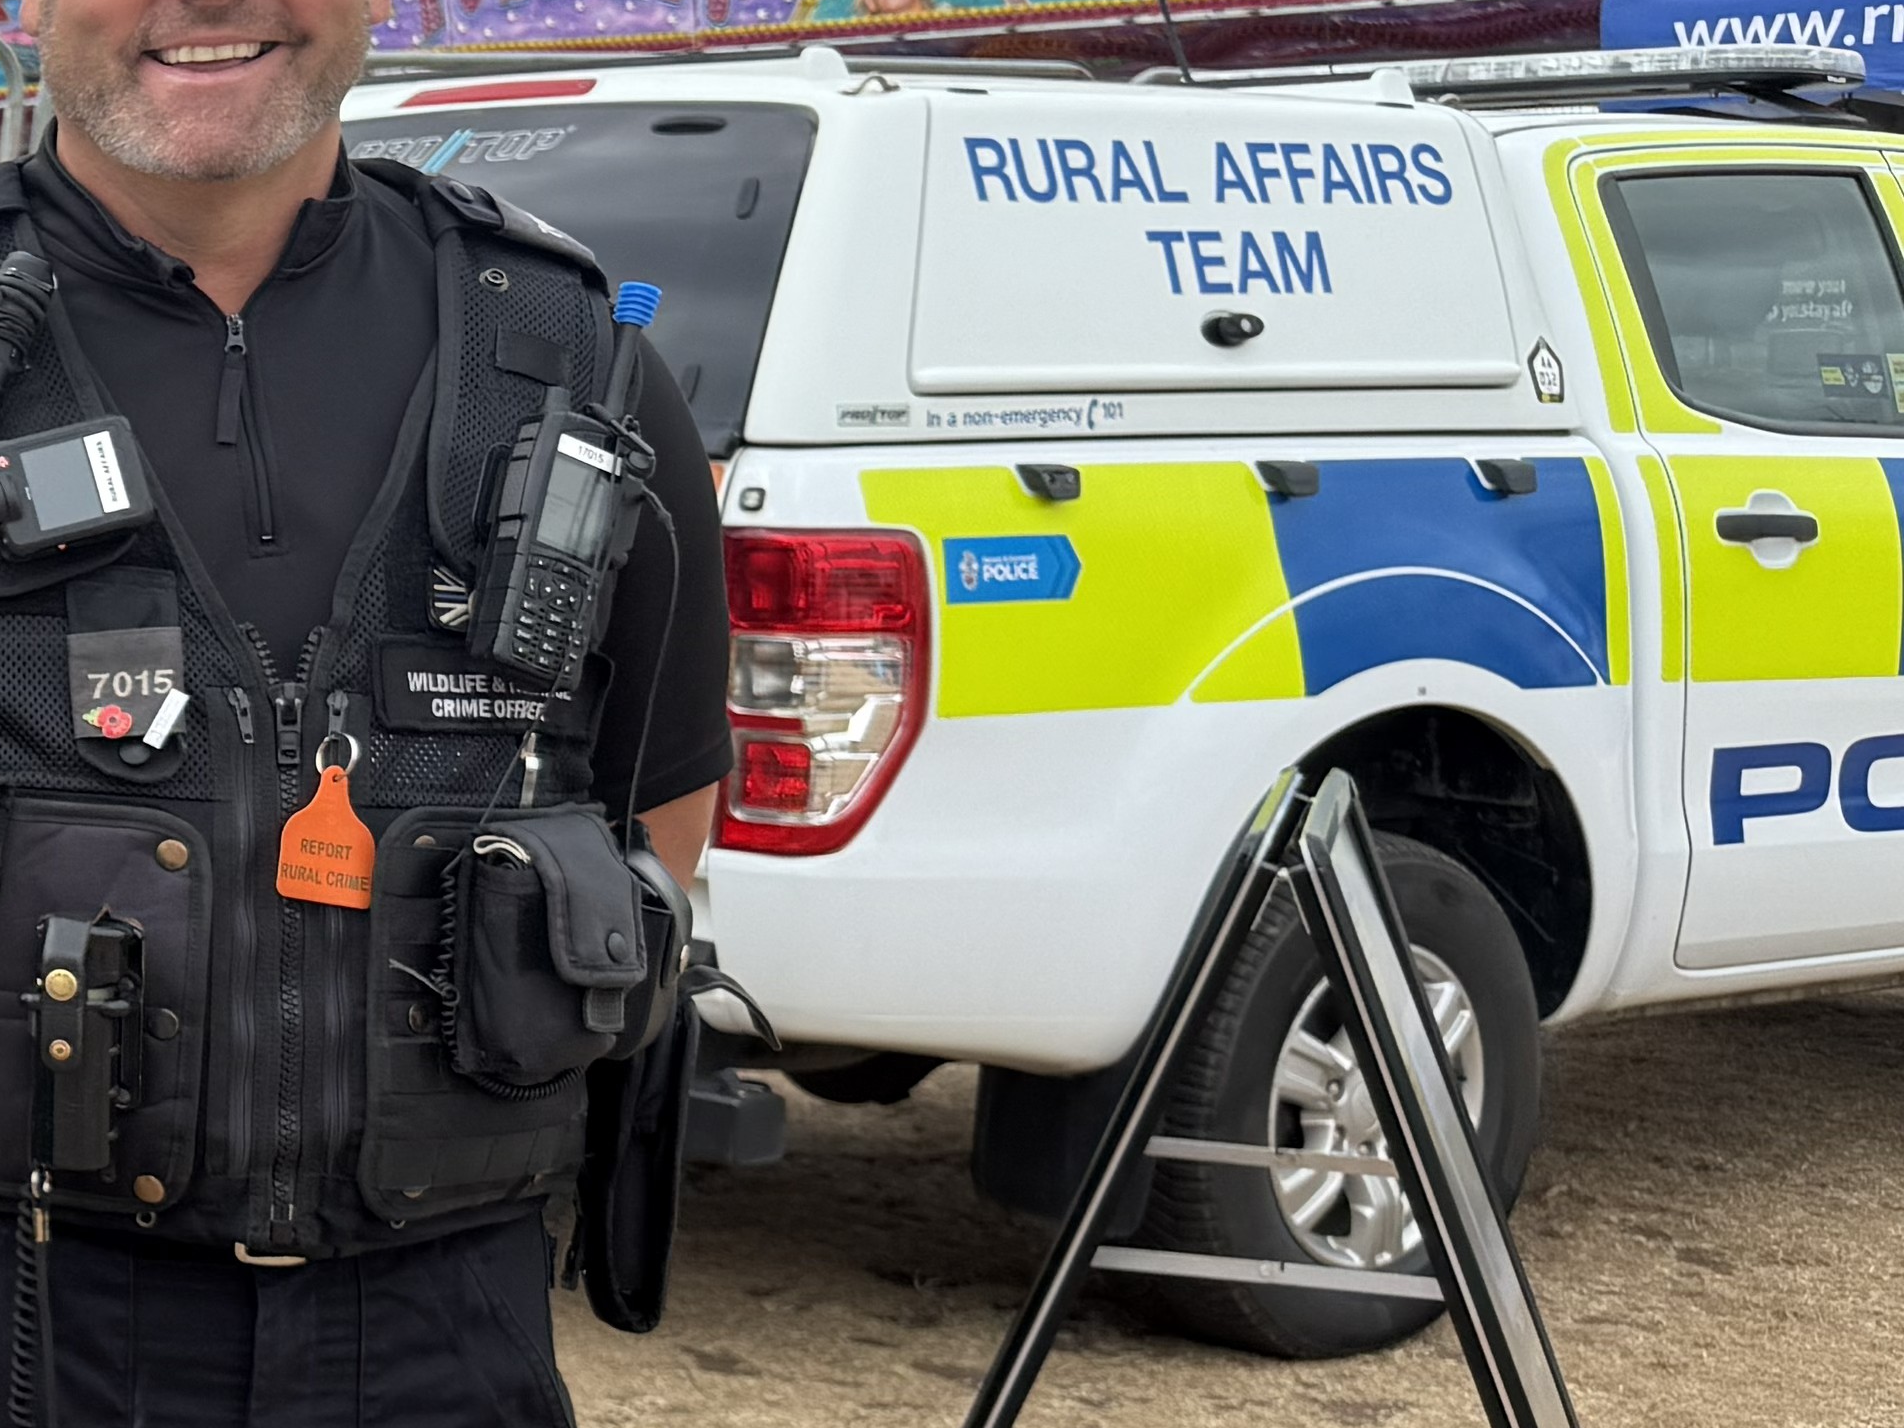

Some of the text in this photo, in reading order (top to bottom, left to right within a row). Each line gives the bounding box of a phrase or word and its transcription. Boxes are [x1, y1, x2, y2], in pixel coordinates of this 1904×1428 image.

[963, 137, 1452, 205] RURAL AFFAIRS
[1145, 230, 1333, 295] TEAM
[946, 412, 957, 427] a
[962, 408, 1082, 427] non-emergency
[1102, 401, 1123, 420] 101
[578, 445, 604, 463] 17015
[983, 562, 1039, 582] POLICE
[87, 669, 174, 699] 7015
[407, 672, 489, 694] WILDLIFE
[431, 698, 491, 718] CRIME
[300, 838, 352, 860] REPORT
[280, 863, 369, 891] RURAL CRIME
